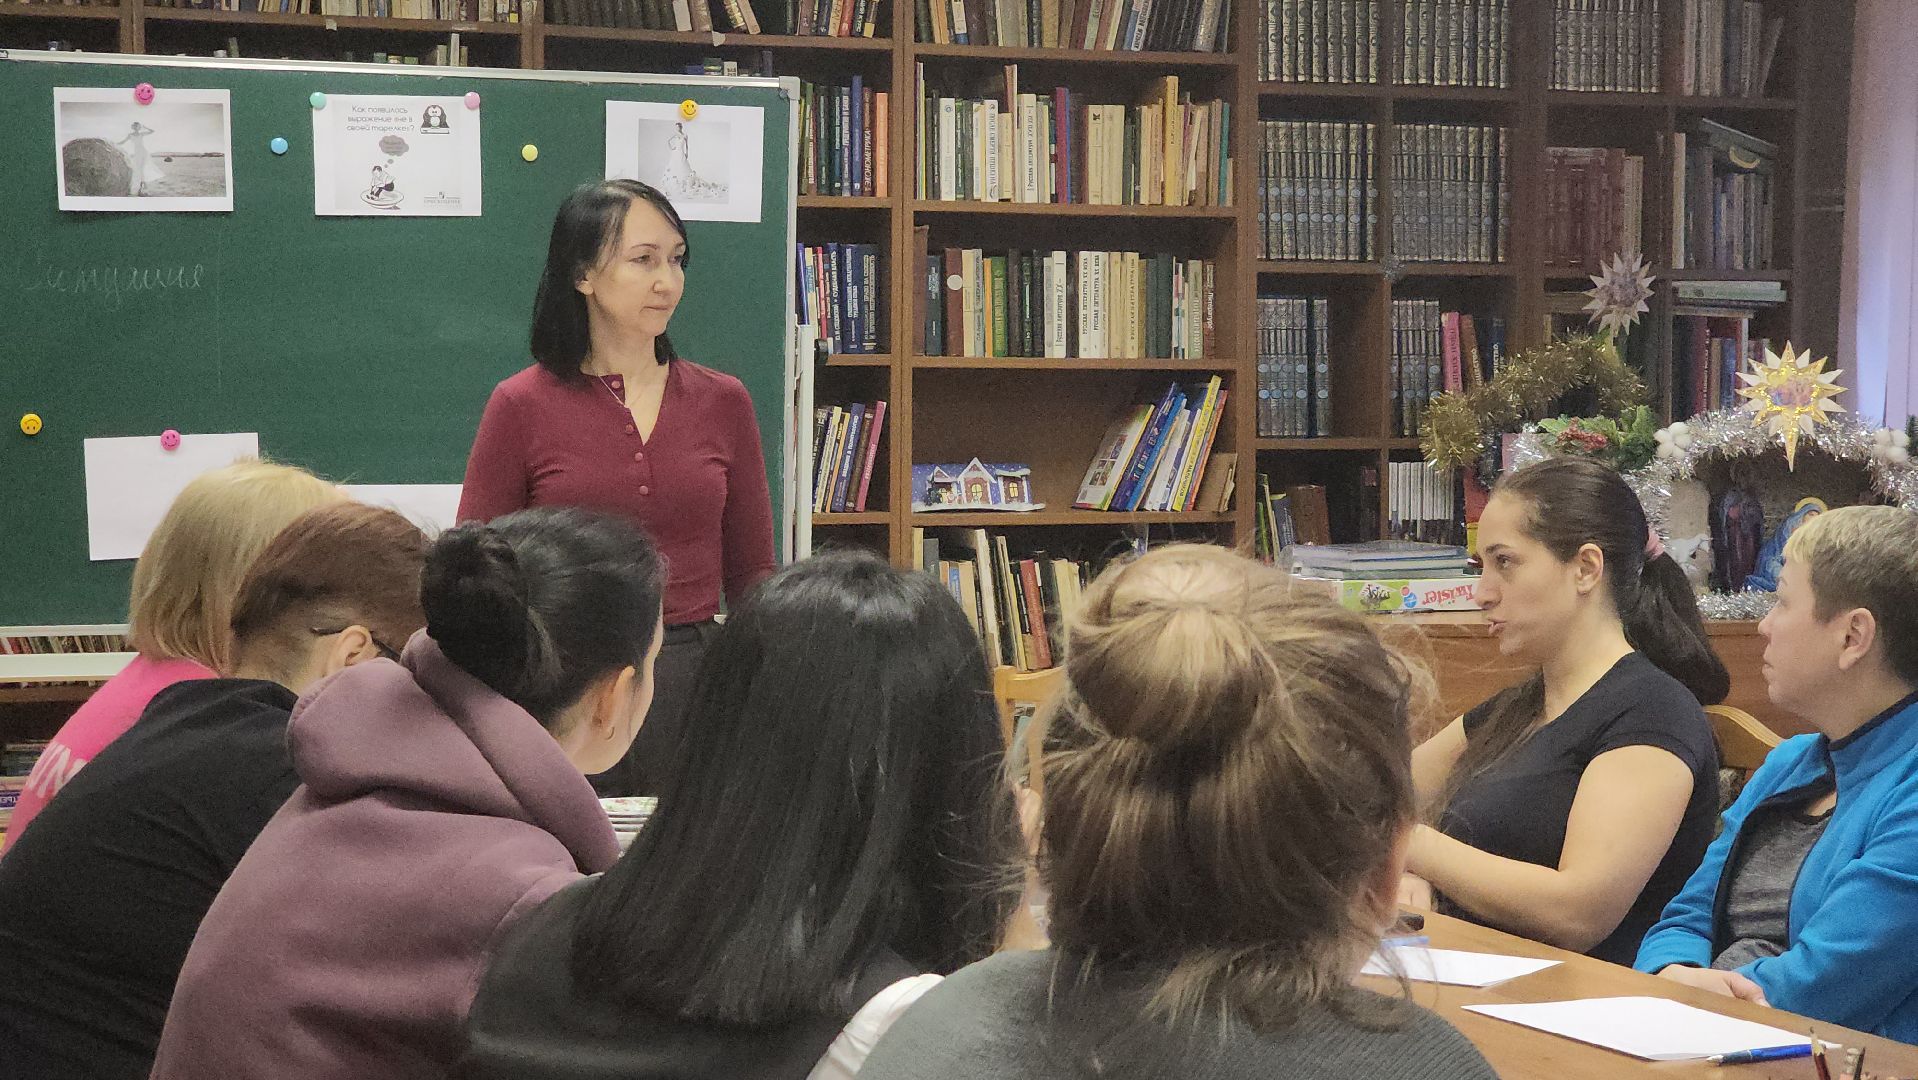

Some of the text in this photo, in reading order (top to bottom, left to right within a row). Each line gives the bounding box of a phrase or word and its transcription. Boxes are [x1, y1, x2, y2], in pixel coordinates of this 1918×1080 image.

[352, 105, 409, 115] Как появилось
[347, 116, 392, 124] выражение
[864, 129, 872, 188] ЭКОНОМЕТРИКА
[1422, 584, 1475, 606] Twister
